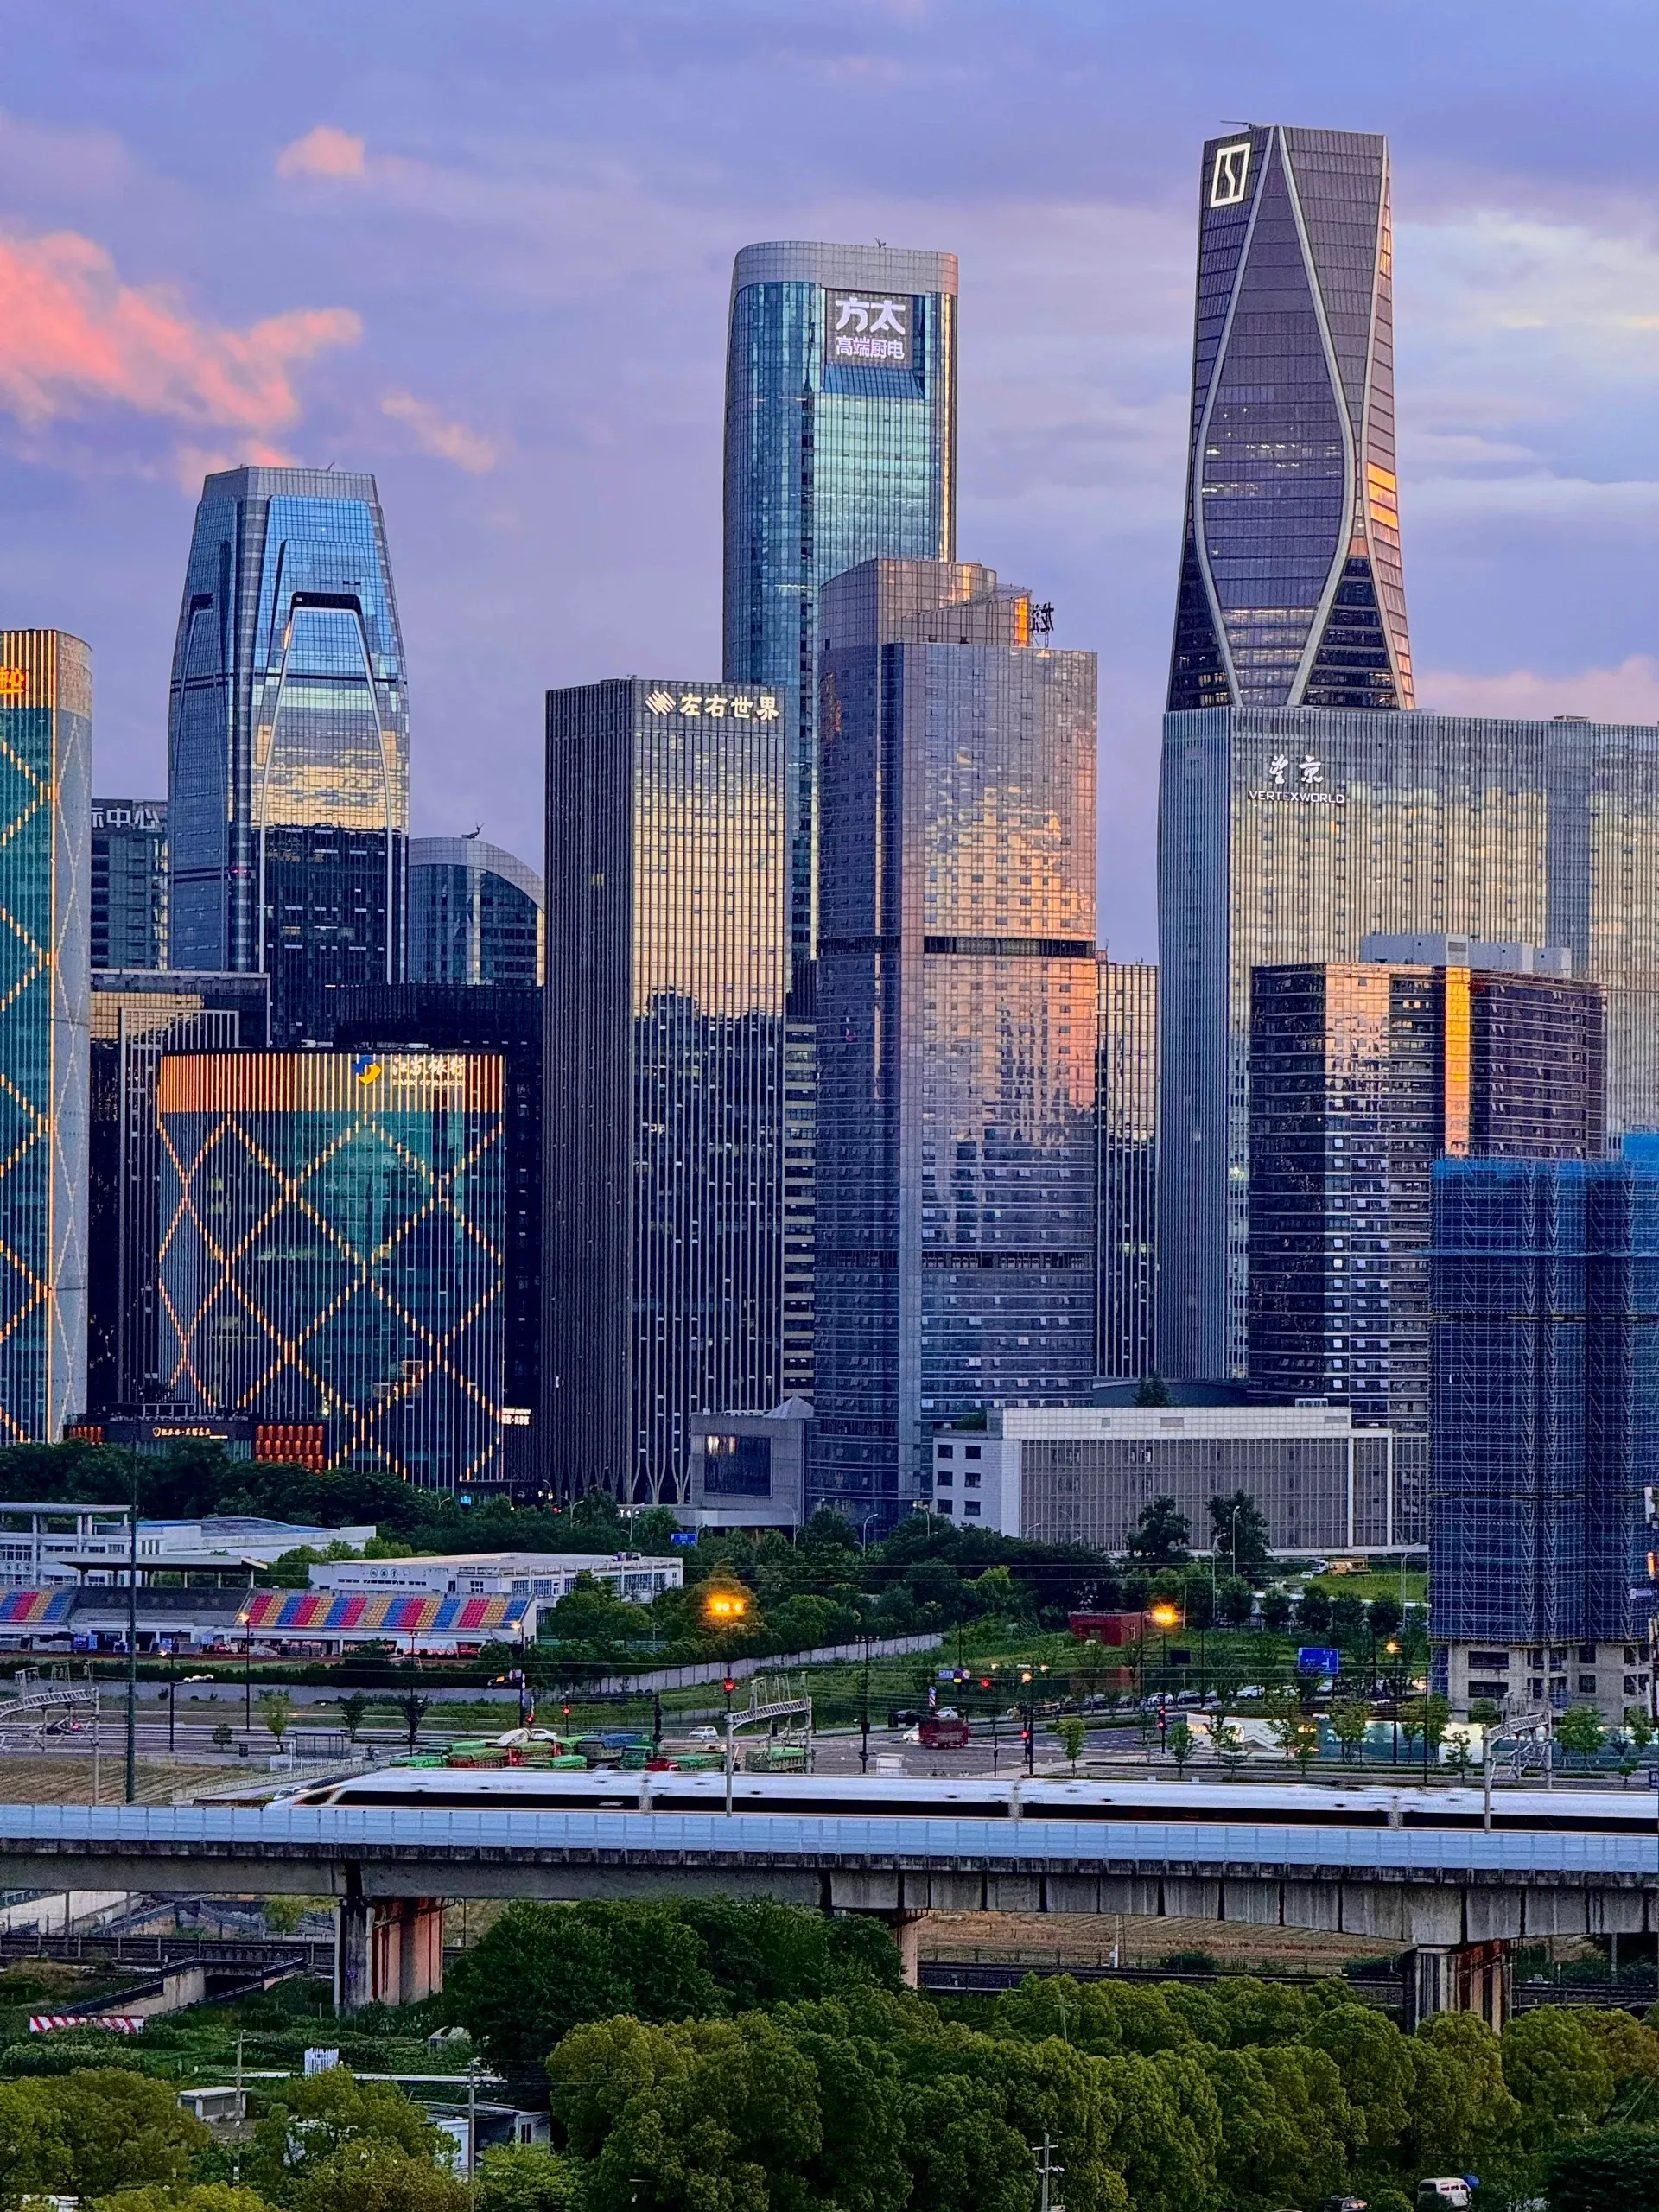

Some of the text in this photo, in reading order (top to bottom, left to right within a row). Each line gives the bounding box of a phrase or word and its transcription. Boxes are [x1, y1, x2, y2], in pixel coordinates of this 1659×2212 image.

[835, 296, 906, 335] 方太
[836, 335, 905, 359] 高端厨电
[679, 692, 779, 721] 左右世界
[392, 1056, 466, 1077] 江苏银行
